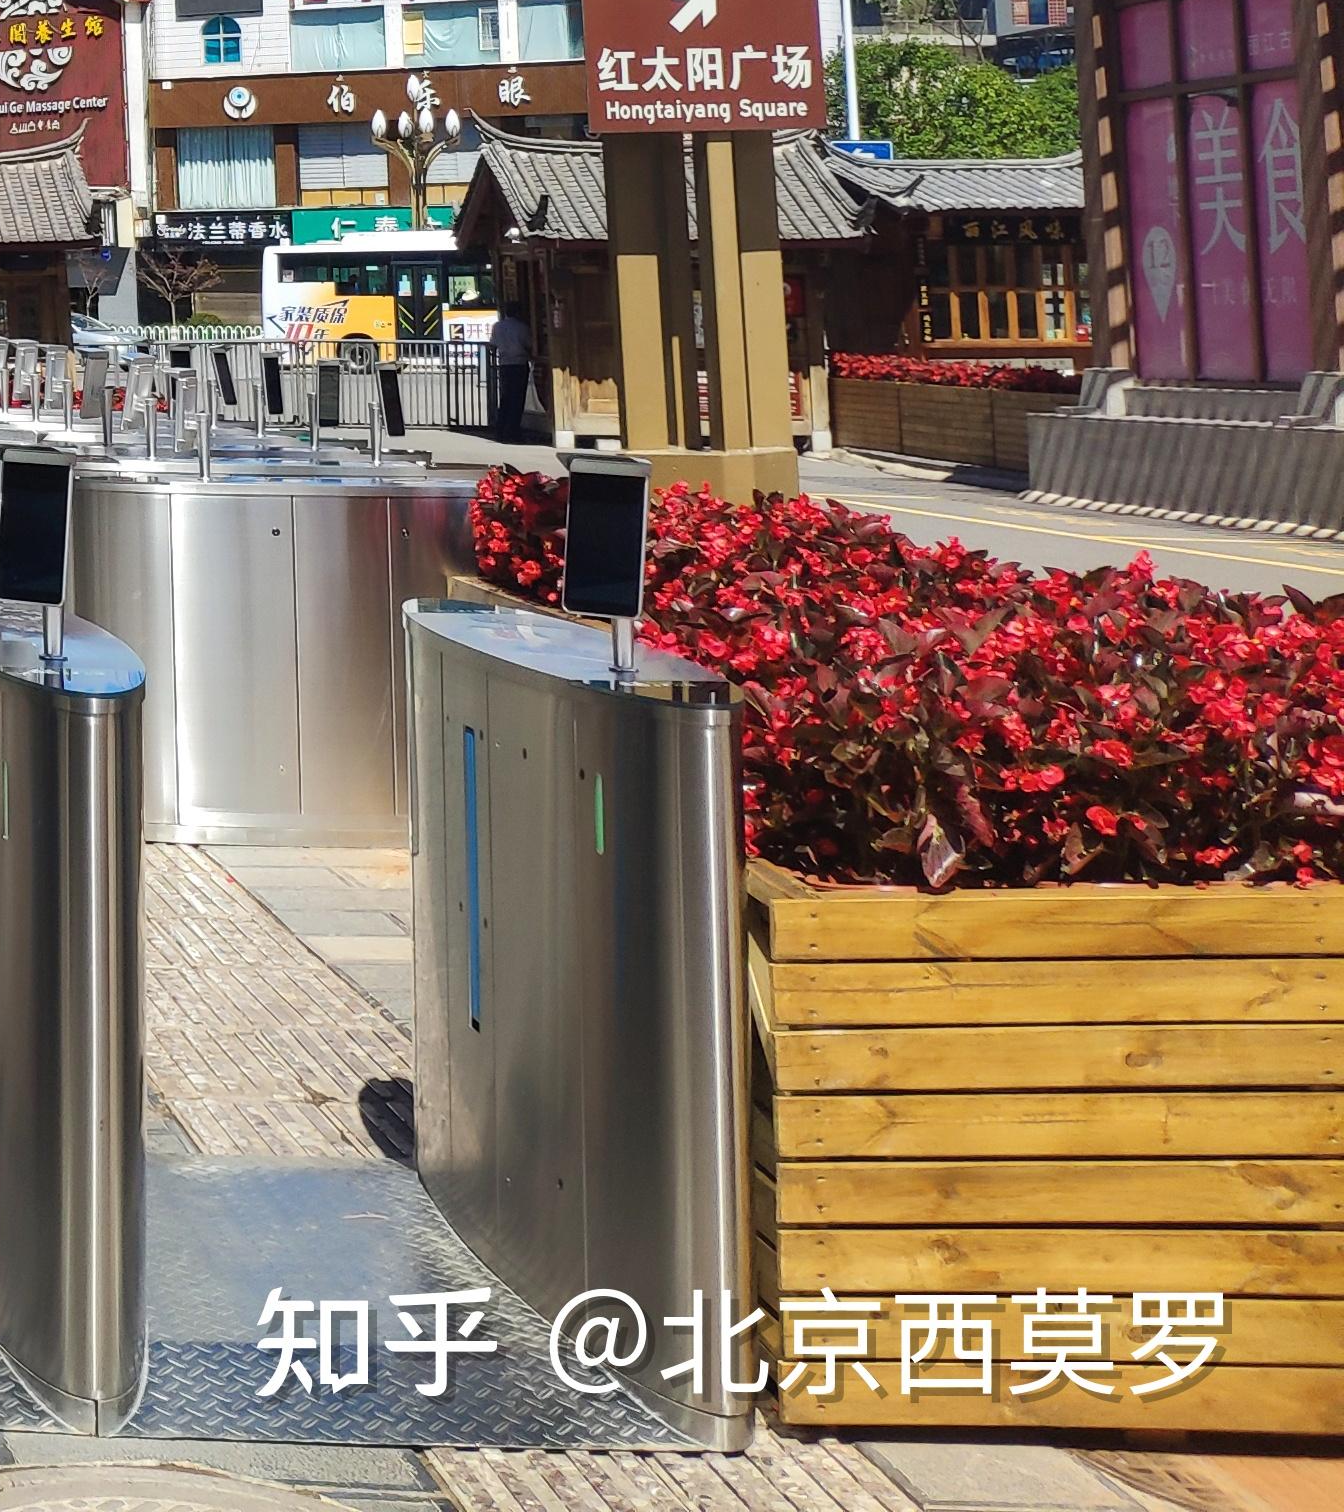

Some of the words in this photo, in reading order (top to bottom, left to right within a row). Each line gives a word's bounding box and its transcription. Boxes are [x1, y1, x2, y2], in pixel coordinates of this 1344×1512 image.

[597, 44, 813, 92] 红太阳广场
[9, 101, 24, 114] Ge
[25, 99, 71, 114] Massage
[72, 96, 109, 110] Center
[605, 101, 731, 126] Hongtaiyang
[738, 98, 809, 122] Square
[187, 221, 288, 240] 法兰蒂香水
[280, 305, 348, 324] 家装质保
